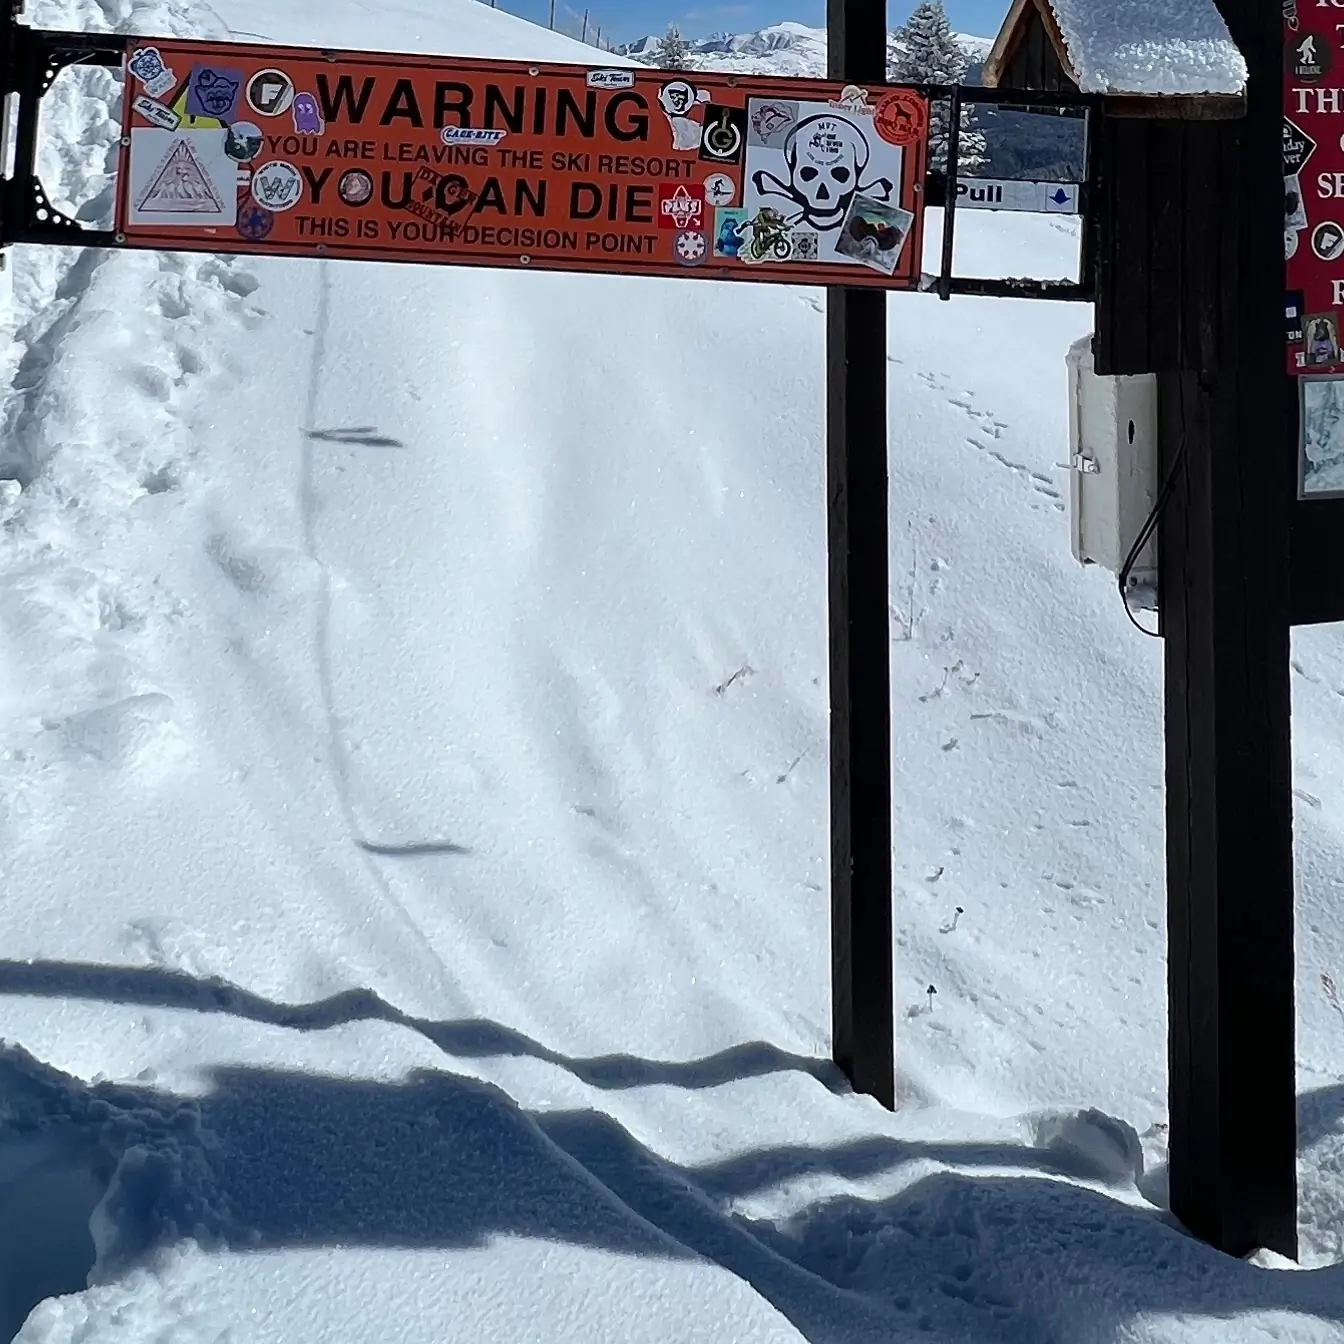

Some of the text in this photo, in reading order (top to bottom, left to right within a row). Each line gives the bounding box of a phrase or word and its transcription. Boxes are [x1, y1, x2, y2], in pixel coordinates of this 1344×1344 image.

[316, 73, 650, 141] WARNING
[267, 135, 697, 180] YOU ARE LEAVING THE SKI RESORT
[302, 165, 654, 223] YOU CAN DIE
[295, 215, 658, 254] THIS IS YOUR DECISION POINT
